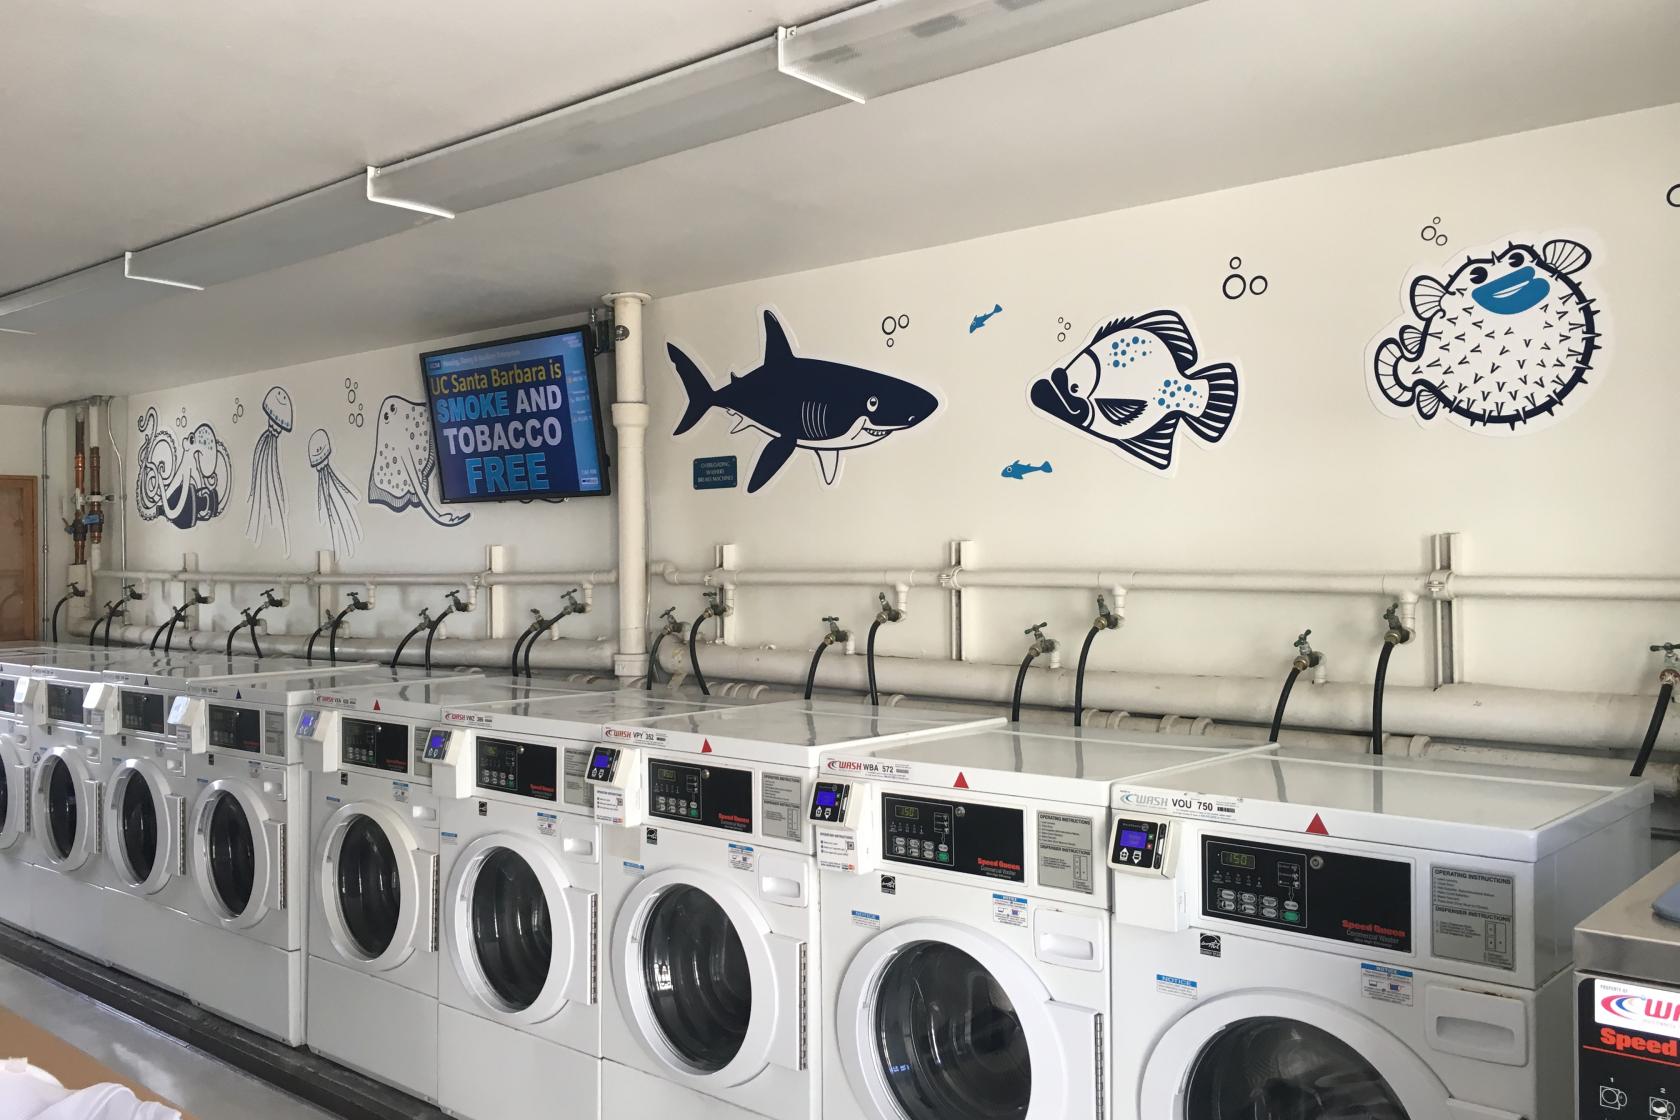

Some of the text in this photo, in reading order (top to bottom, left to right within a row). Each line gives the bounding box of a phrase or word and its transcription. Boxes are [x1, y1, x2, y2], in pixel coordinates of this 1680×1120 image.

[431, 359, 562, 396] UC Santa Barbara is
[436, 390, 510, 423] SMOKE
[516, 385, 562, 414] AND
[443, 416, 562, 455] TOBACCO
[465, 452, 550, 494] FREE
[838, 760, 894, 774] WASH WBA 572
[1136, 794, 1214, 812] WASH VOU 750
[1434, 869, 1511, 885] OPERATING INSTRUCTIONS
[1435, 905, 1511, 923] DISPENSER INSTRUCTIONS
[1342, 919, 1406, 937] Speed Queen
[1162, 976, 1192, 987] NOTICE
[1600, 1027, 1678, 1057] Speed
